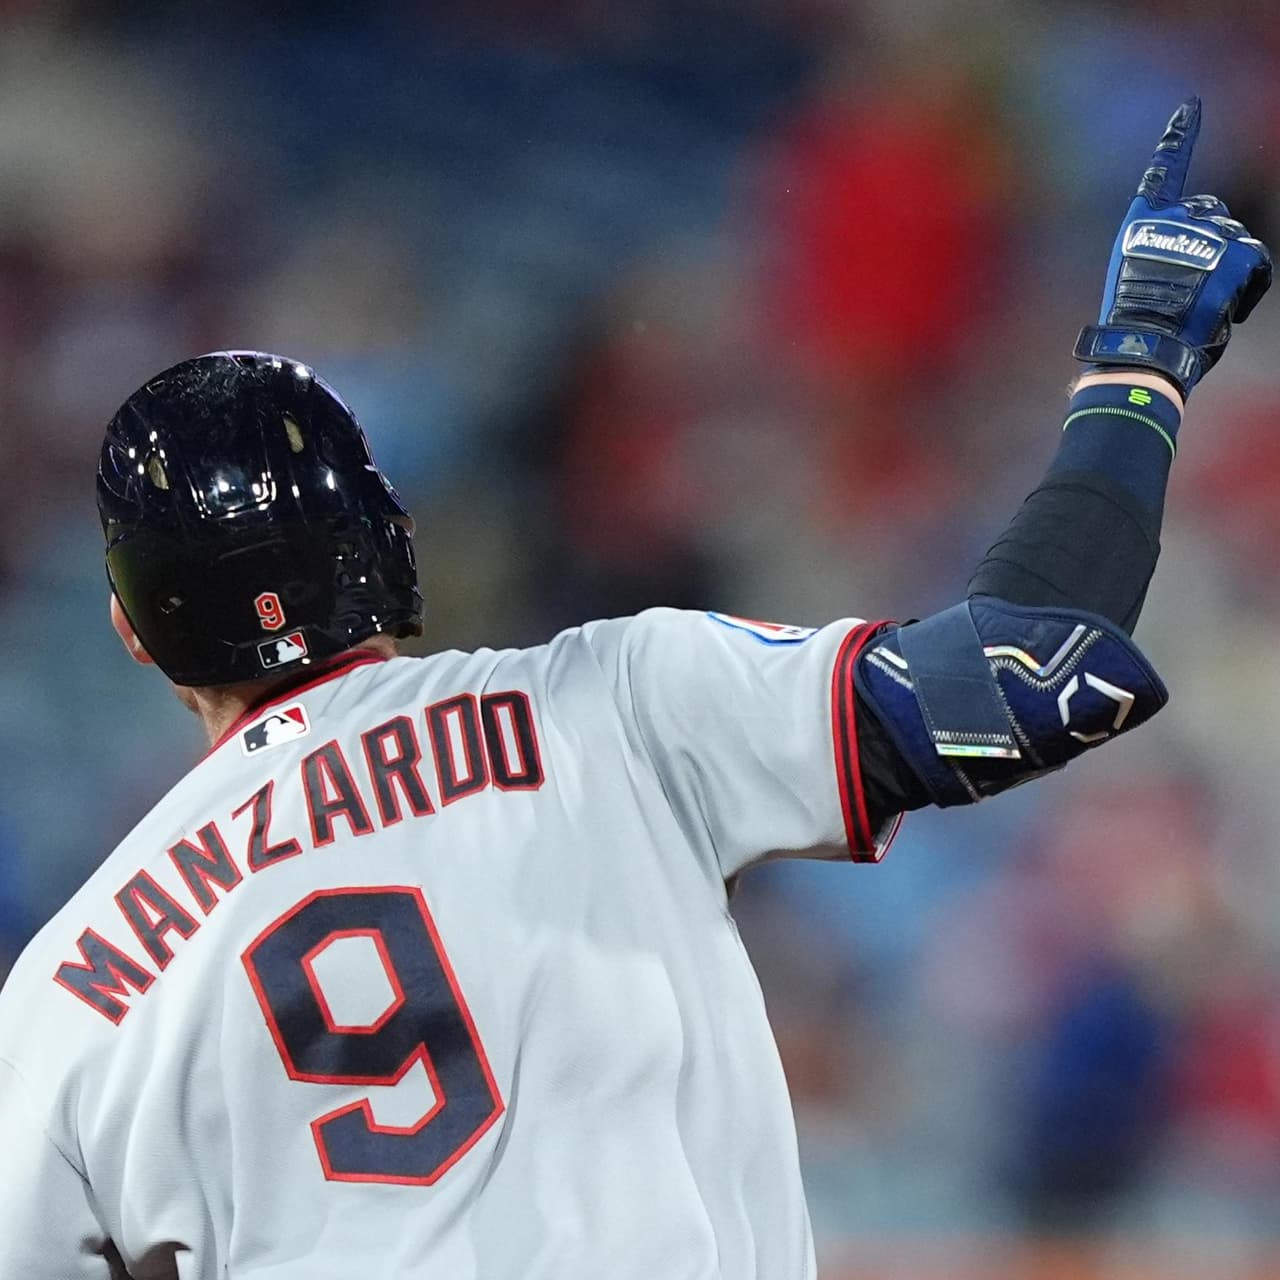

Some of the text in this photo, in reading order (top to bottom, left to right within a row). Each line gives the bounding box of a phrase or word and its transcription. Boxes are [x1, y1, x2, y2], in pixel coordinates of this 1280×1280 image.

[1126, 225, 1217, 260] Franklin
[254, 591, 287, 631] 9
[52, 689, 546, 1026] MANZARDO
[239, 885, 506, 1187] 9
